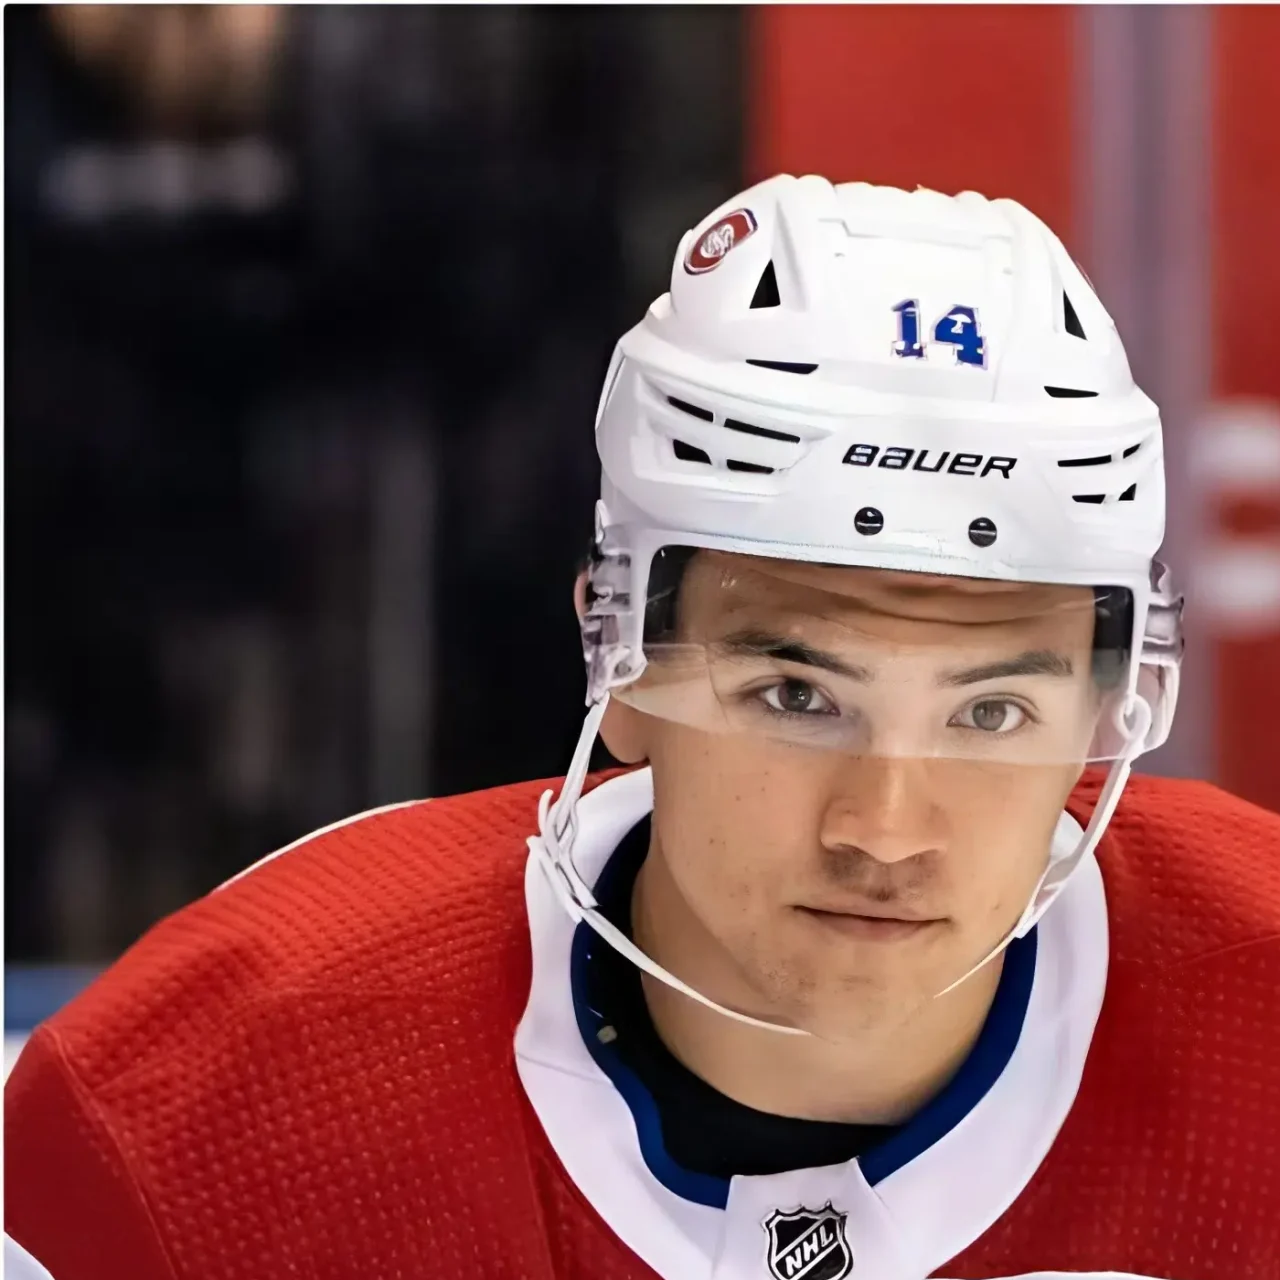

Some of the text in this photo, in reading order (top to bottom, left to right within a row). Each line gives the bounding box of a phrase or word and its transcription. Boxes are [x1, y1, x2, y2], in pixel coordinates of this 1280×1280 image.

[891, 299, 988, 370] 14
[842, 443, 1018, 479] BAUER
[785, 1224, 834, 1277] NHL
